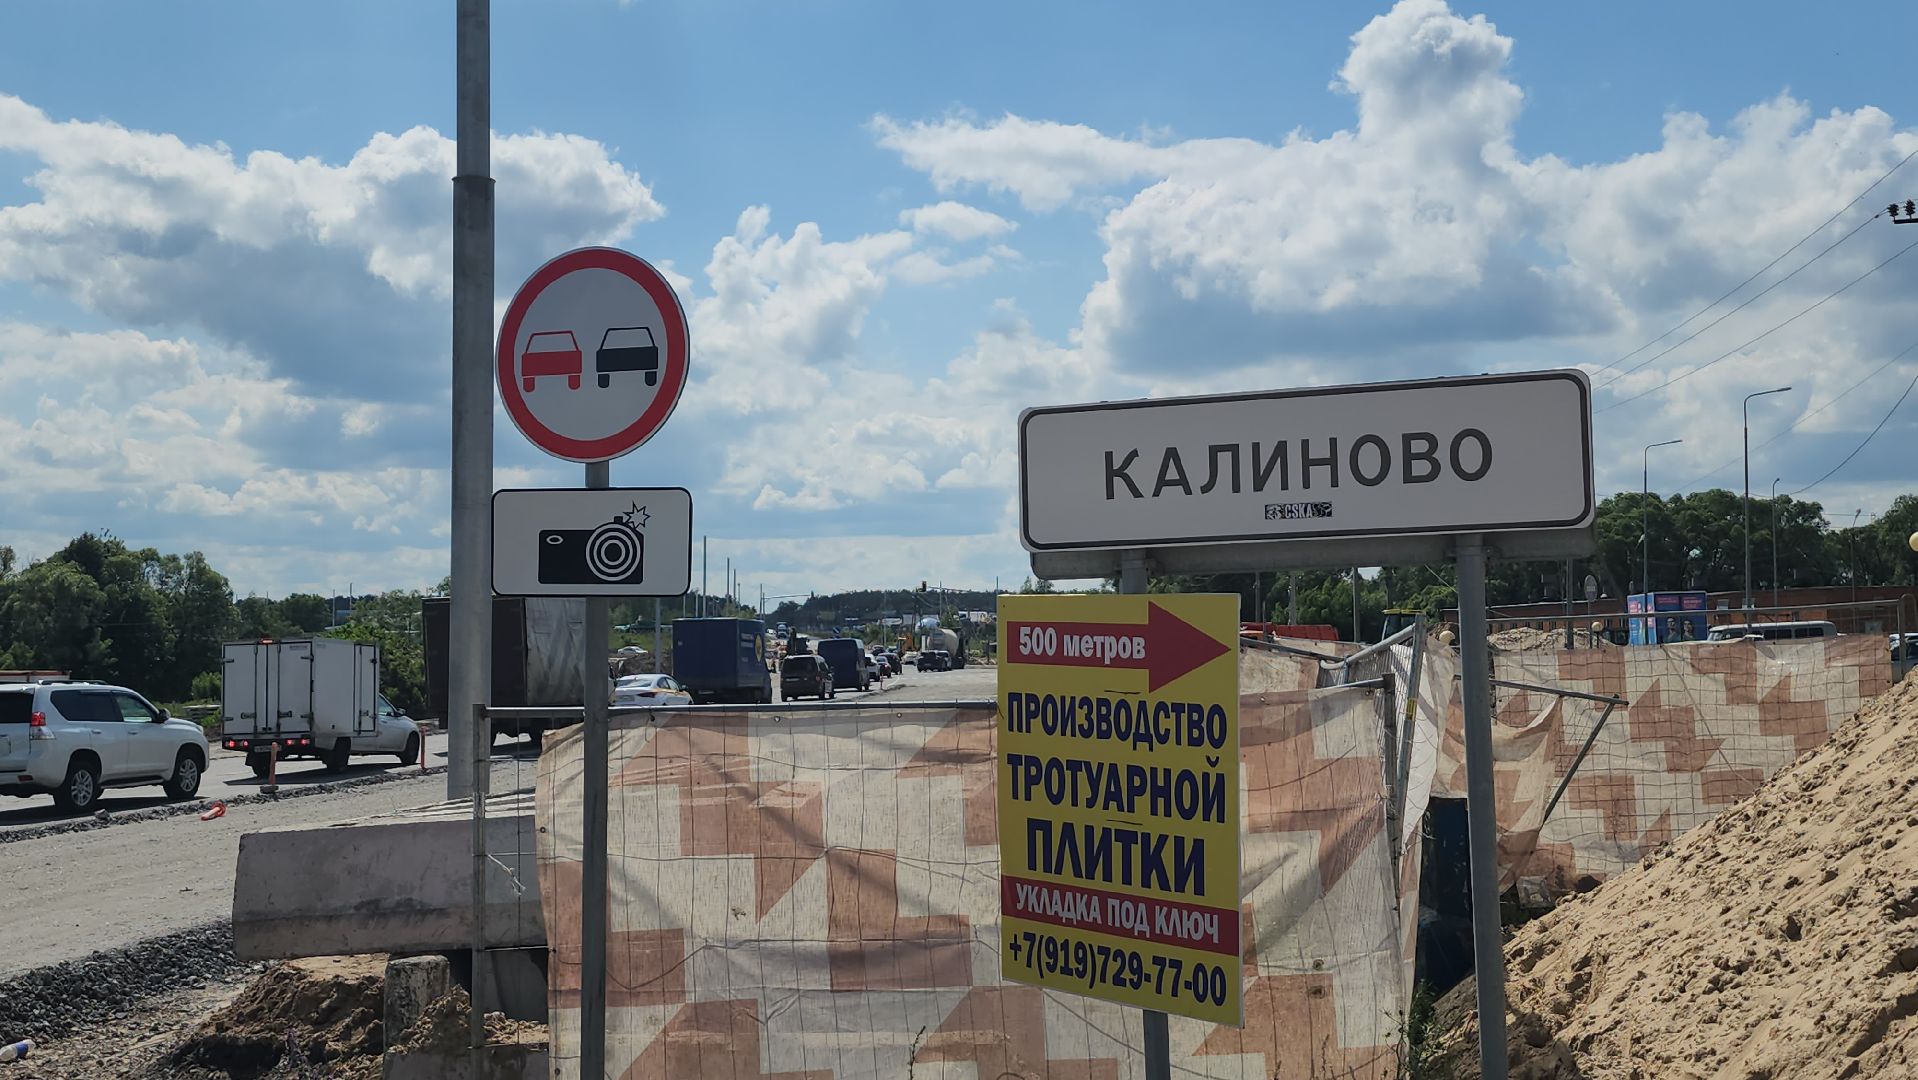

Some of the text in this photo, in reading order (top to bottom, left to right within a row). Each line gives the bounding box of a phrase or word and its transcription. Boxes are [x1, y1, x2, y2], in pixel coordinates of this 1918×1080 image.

[1104, 428, 1493, 500] КАЛИНОВО
[1284, 503, 1313, 519] CSKA
[1019, 626, 1146, 665] 500 метров
[1007, 692, 1227, 752] ПРОИЗВОДСТВО
[1007, 753, 1226, 824] ТРОТУАРНОЙ
[1027, 817, 1205, 897] ПЛИТКИ
[1015, 882, 1219, 944] УКЛАДКА ПОД КЛЮЧ
[1009, 931, 1227, 1007] +7(919)729-77-00
